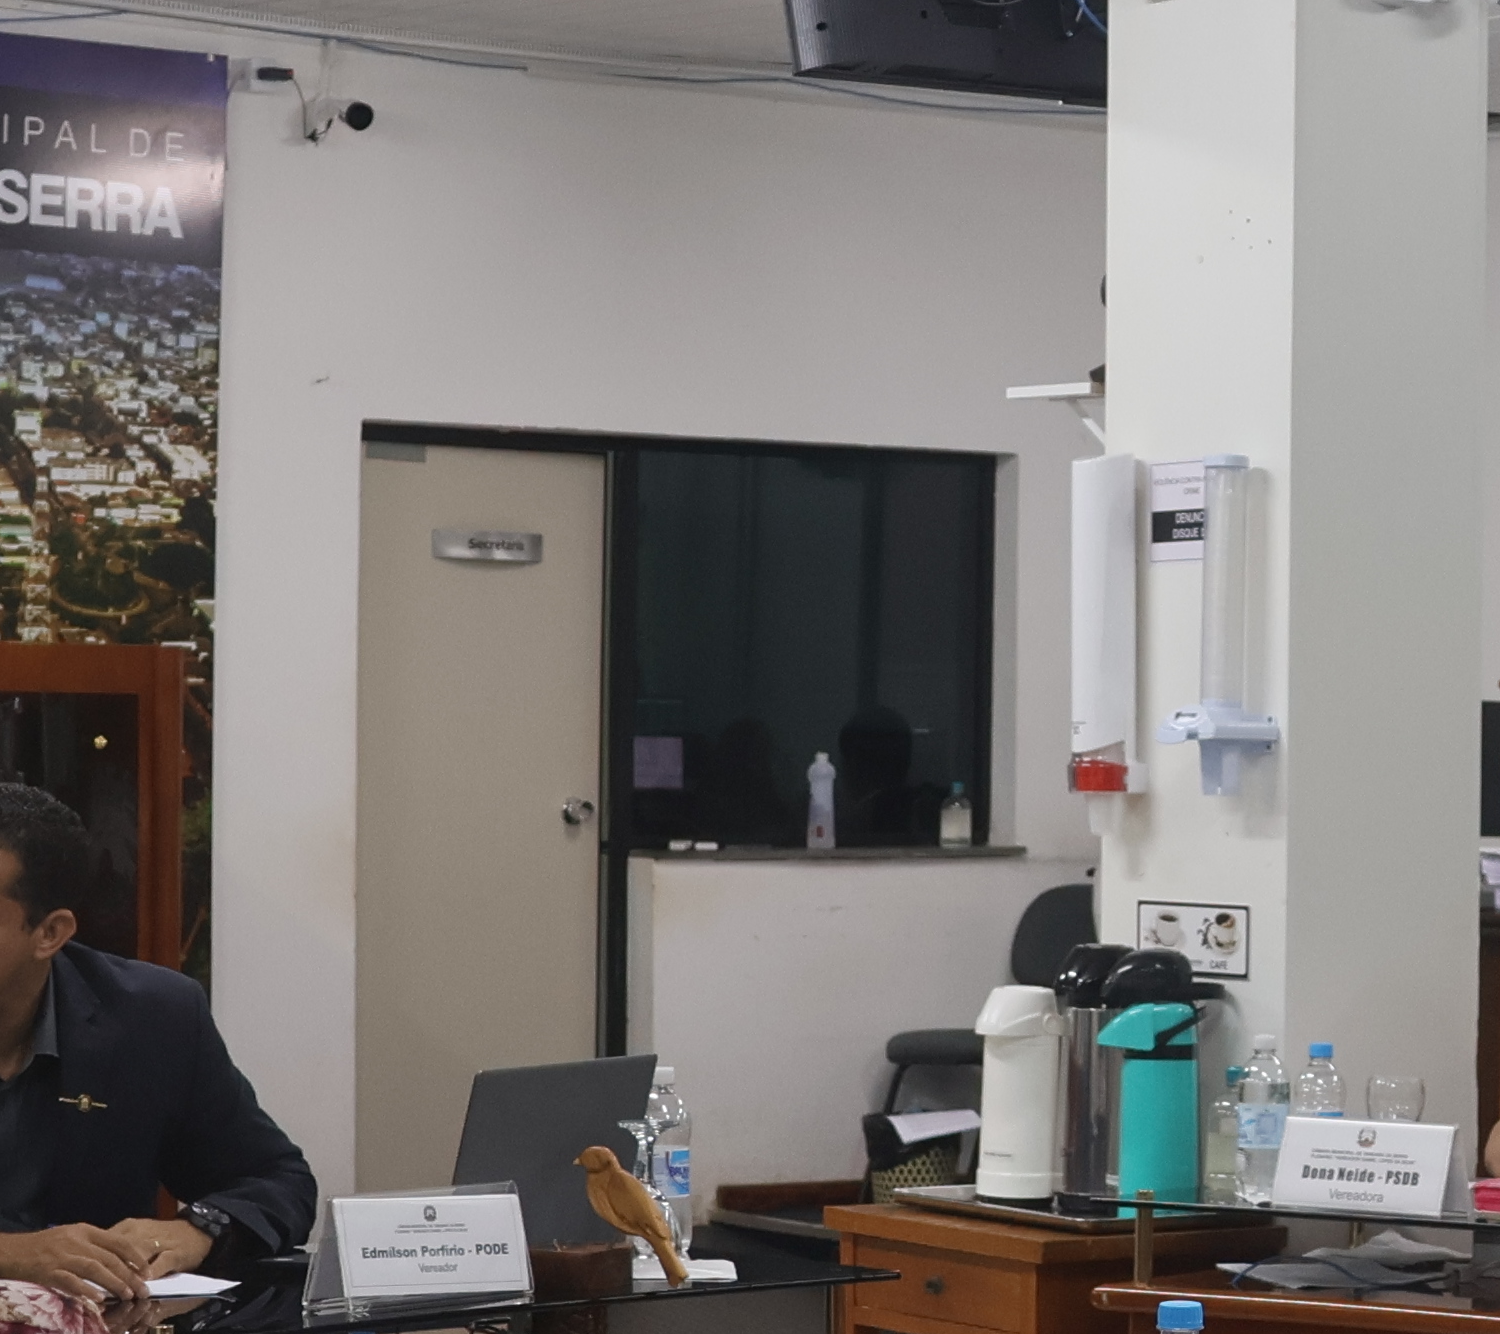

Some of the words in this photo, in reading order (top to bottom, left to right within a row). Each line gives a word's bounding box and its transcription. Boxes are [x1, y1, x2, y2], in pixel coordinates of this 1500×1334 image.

[130, 127, 185, 161] DE
[1301, 1164, 1334, 1181] Dona
[1337, 1167, 1375, 1183] Neide
[1384, 1169, 1420, 1186] PSDB
[1328, 1188, 1385, 1203] Vereadora
[361, 1246, 418, 1259] Edmilson
[420, 1245, 465, 1258] Porfirio
[475, 1243, 510, 1256] PODE
[418, 1263, 459, 1273] Vereador
